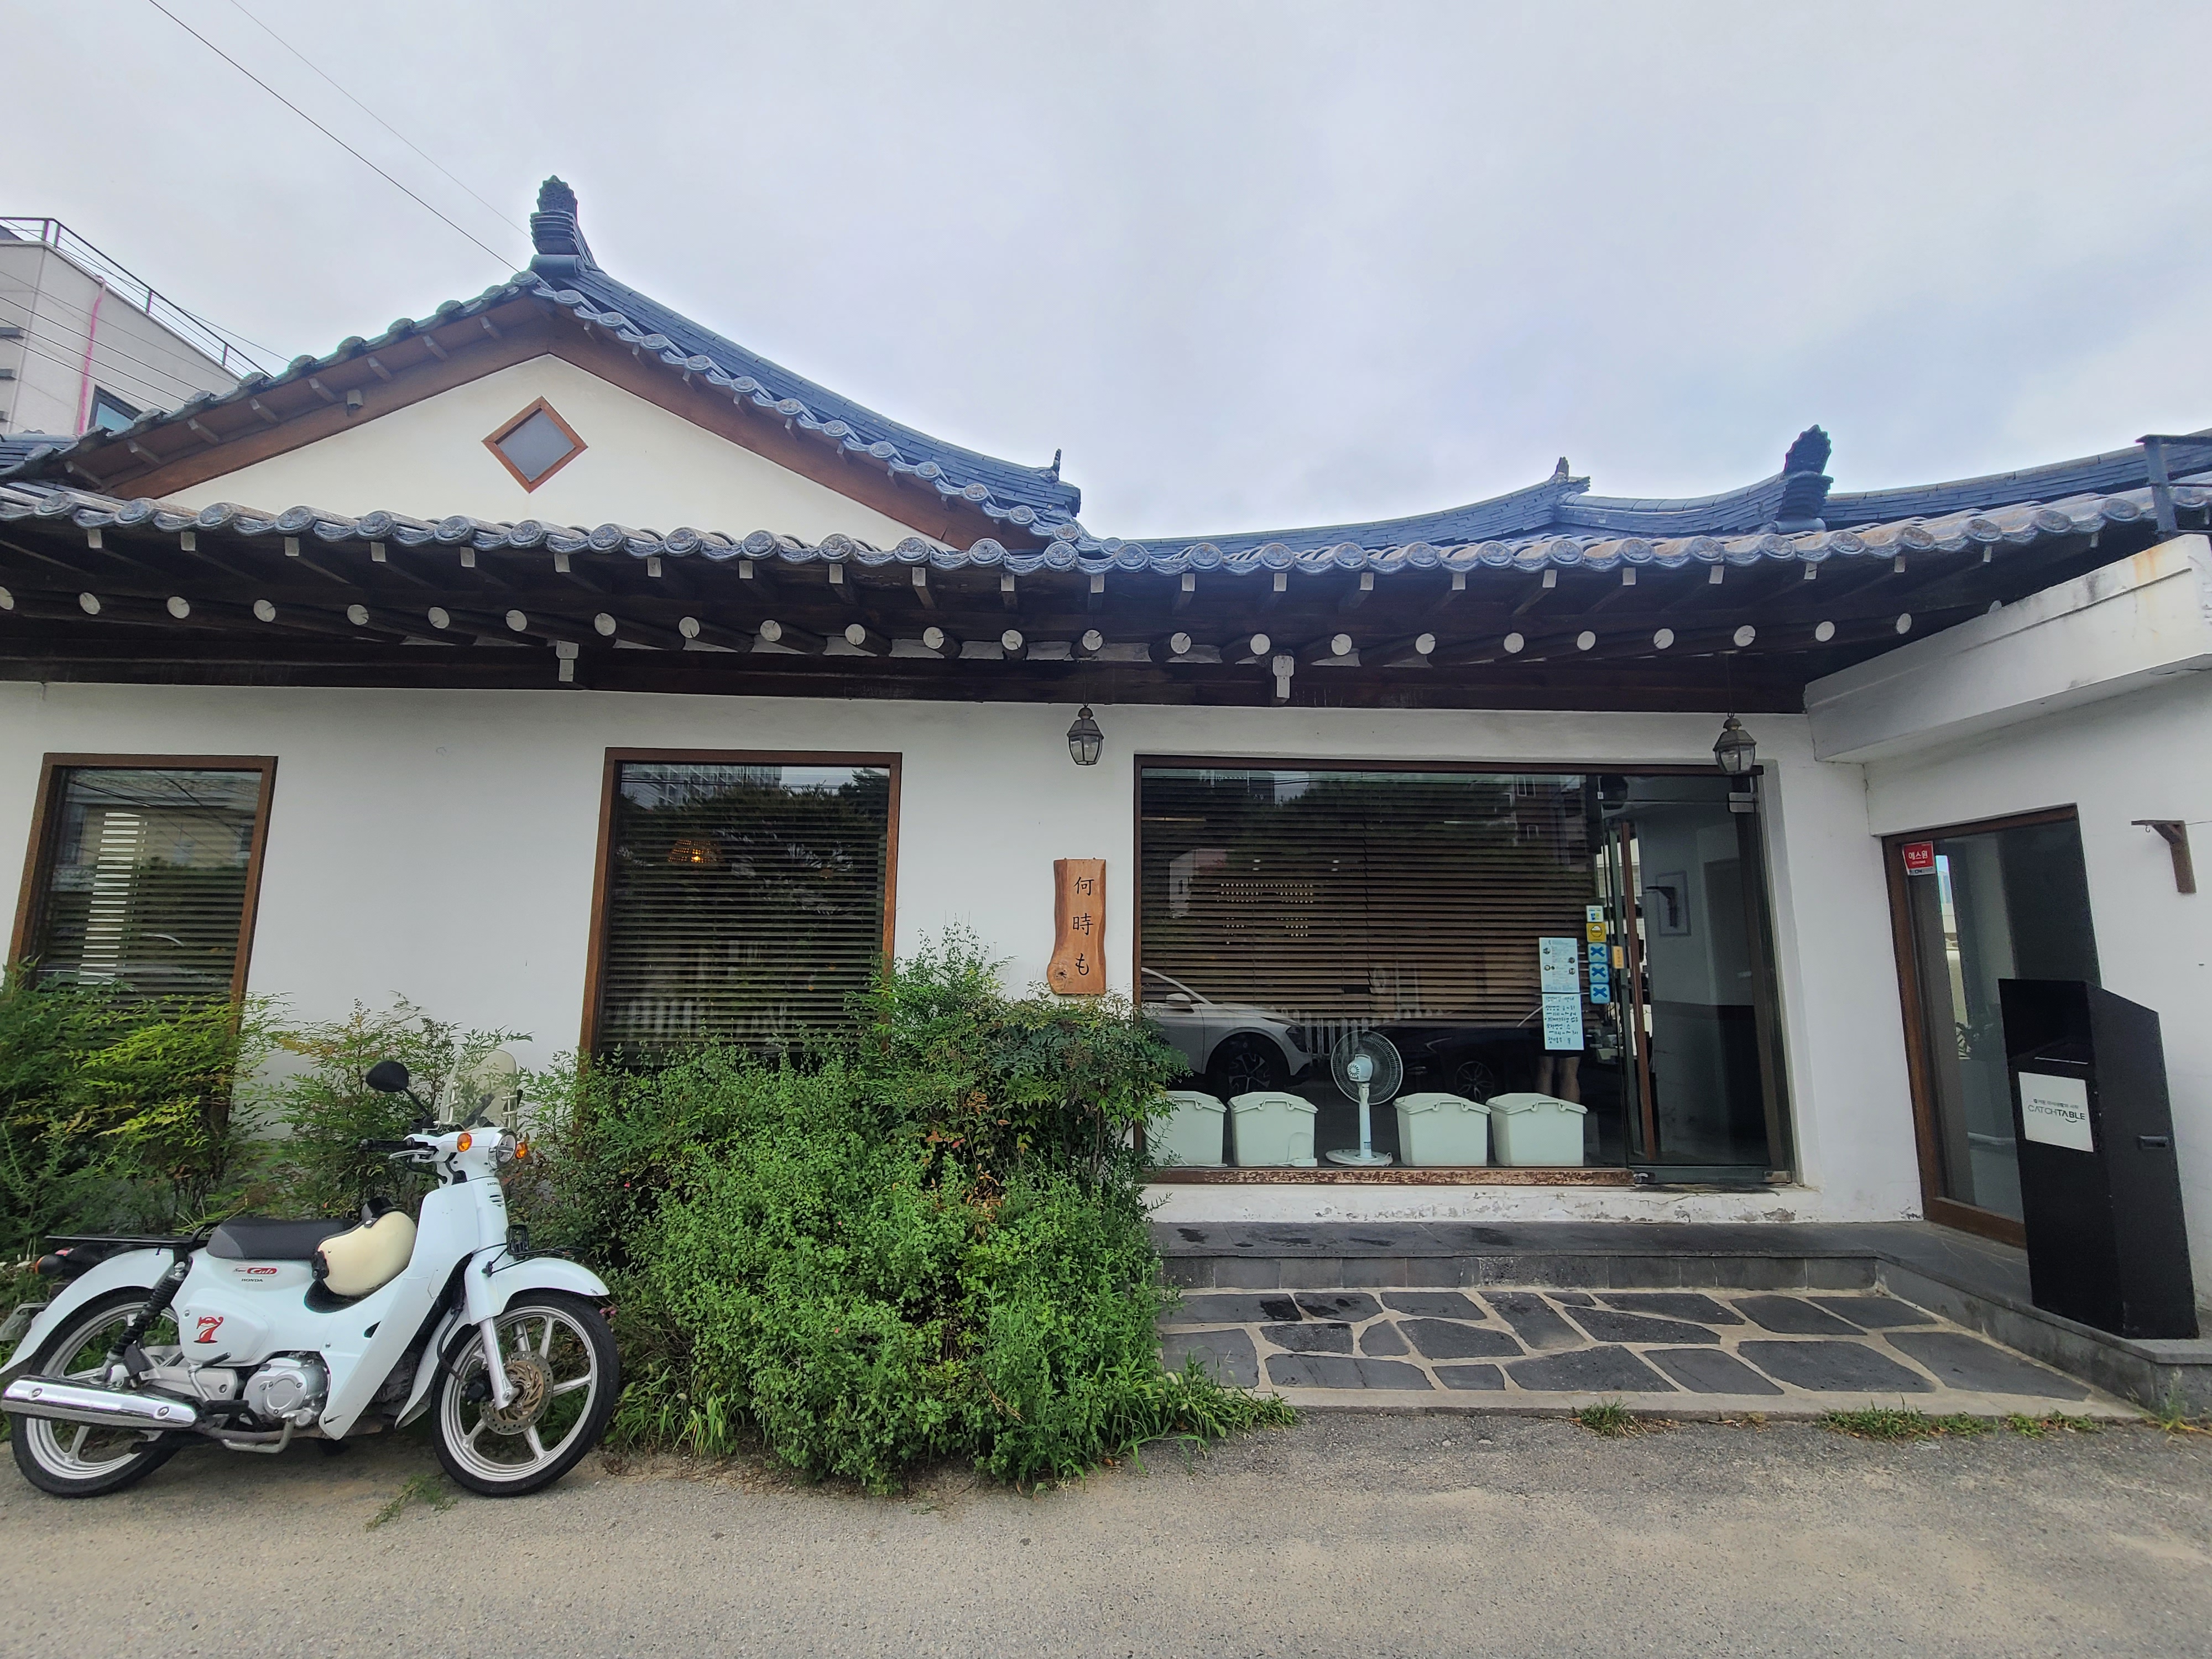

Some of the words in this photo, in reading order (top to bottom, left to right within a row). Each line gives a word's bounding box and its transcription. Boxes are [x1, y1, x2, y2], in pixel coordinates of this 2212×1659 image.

[1908, 850, 1928, 860] 에스원
[1073, 877, 1095, 975] 何時も
[2028, 1105, 2085, 1120] CATCHTABLE
